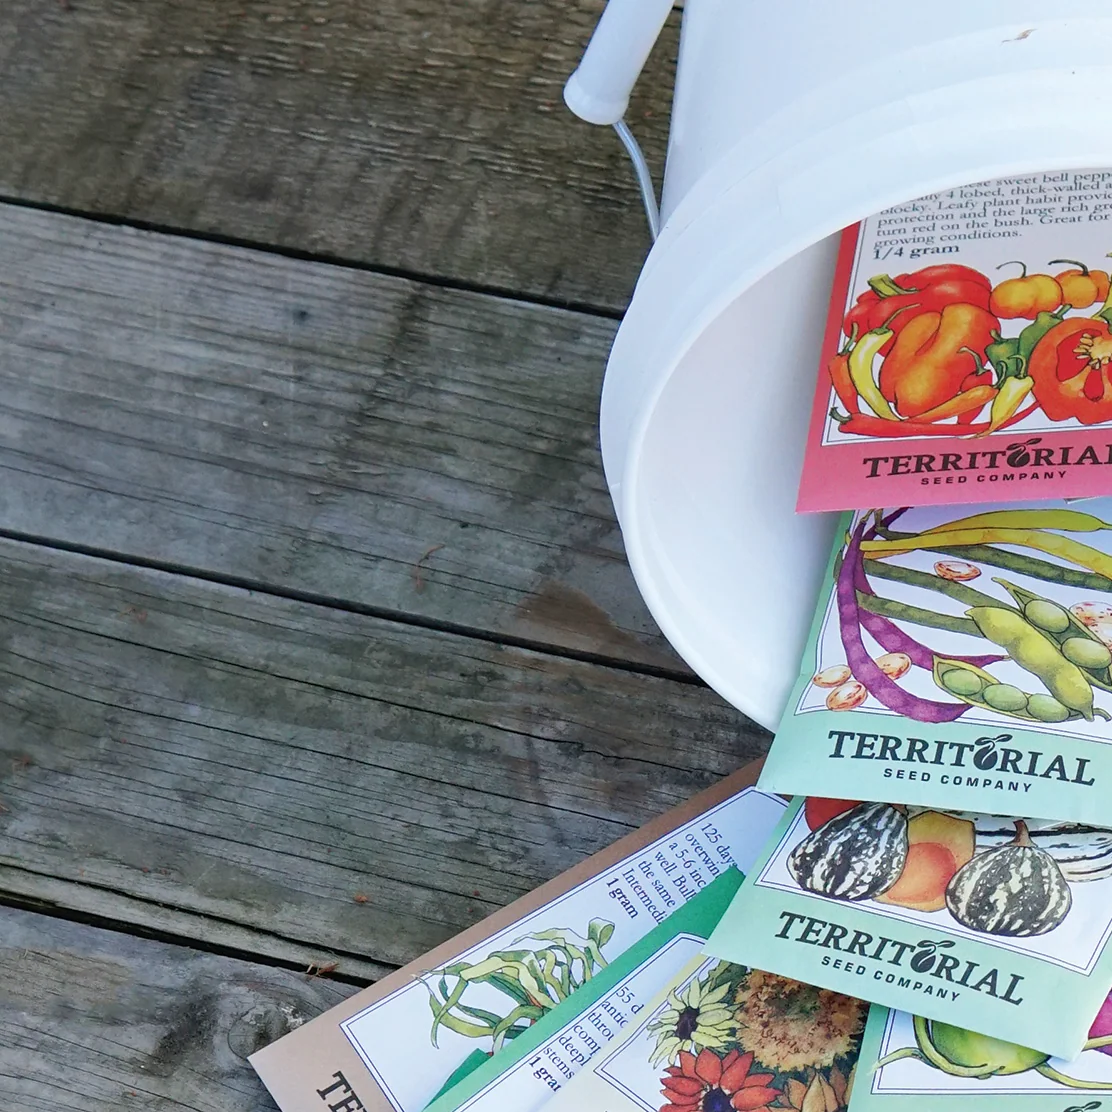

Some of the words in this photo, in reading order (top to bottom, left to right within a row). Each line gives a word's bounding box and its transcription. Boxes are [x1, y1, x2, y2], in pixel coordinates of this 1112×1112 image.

[983, 198, 1020, 212] plant
[1026, 194, 1063, 204] habit
[878, 213, 954, 228] protection
[1021, 206, 1056, 217] large
[1040, 214, 1082, 224] Great
[874, 235, 935, 249] growing
[940, 230, 1022, 241] conditions.
[921, 475, 968, 484] SEED
[977, 470, 1067, 482] COMPANY
[828, 730, 1095, 786] TERRITORIAL
[883, 768, 931, 783] SEED
[940, 774, 1032, 792] COMPANY
[701, 823, 722, 843] 125
[675, 847, 693, 869] 5-6
[638, 860, 654, 879] the
[652, 879, 676, 908] same
[608, 888, 640, 919] gram
[774, 911, 1024, 1006] TERRITORIAL
[822, 956, 866, 975] SEED
[874, 970, 960, 1002] COMPANY
